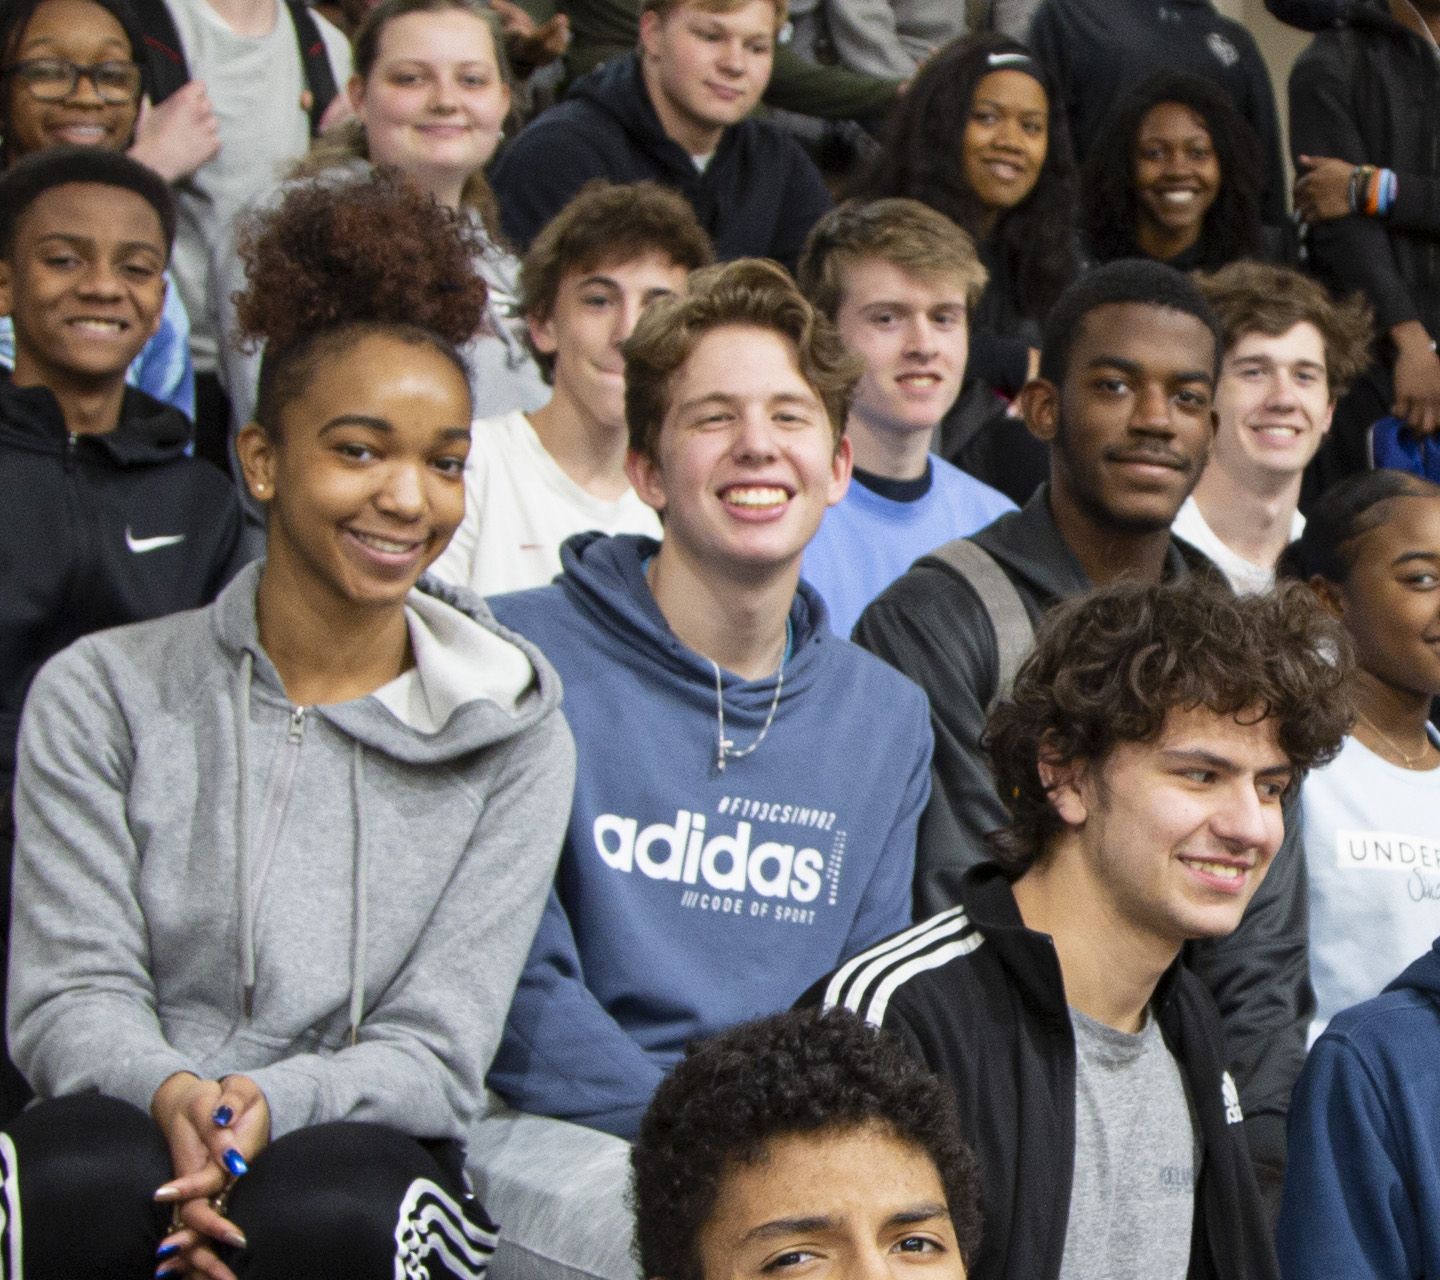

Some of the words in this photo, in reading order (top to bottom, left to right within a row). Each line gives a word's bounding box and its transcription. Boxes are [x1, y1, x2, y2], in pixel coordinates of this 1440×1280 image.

[593, 809, 824, 903] adidas
[750, 901, 769, 918] OF
[774, 905, 816, 926] SPORT
